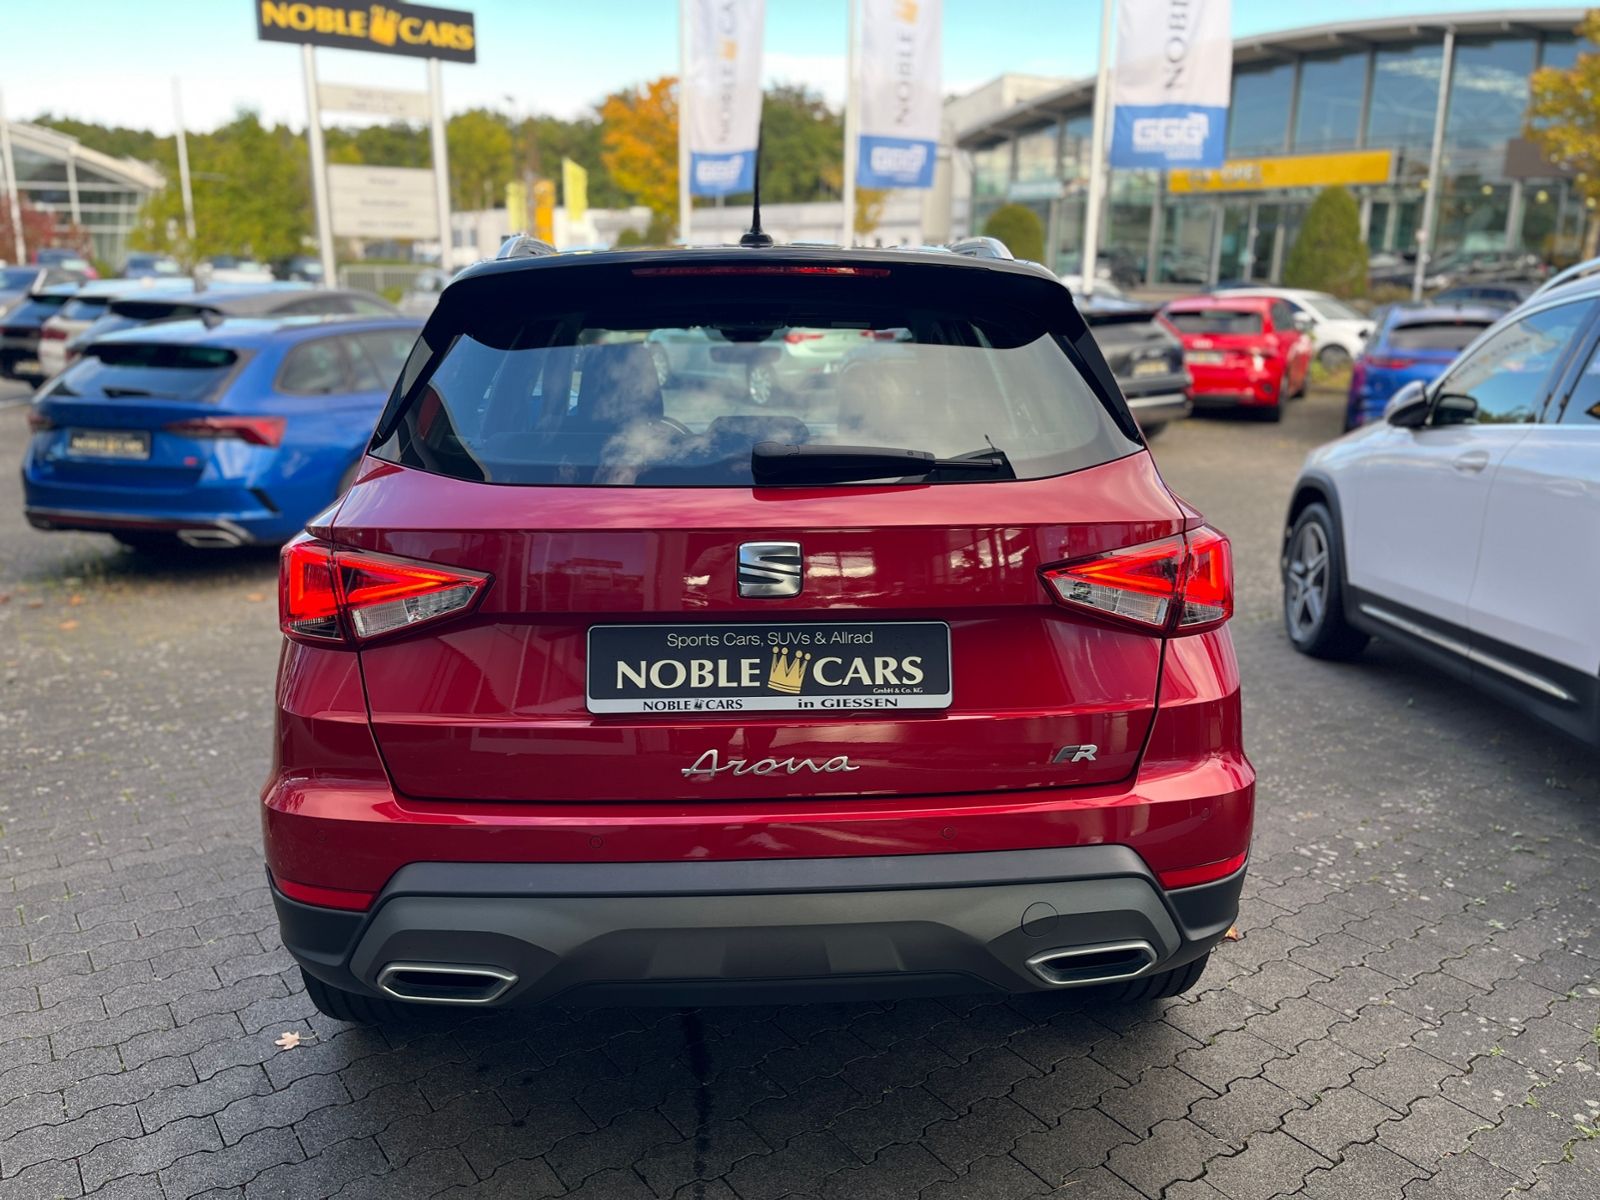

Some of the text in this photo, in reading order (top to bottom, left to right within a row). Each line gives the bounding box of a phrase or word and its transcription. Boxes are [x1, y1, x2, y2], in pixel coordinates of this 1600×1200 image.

[261, 0, 475, 50] NOBLE CARS
[667, 631, 873, 649] Sports Cars, SUVs & Allrad
[616, 656, 924, 689] NOBLE CARS
[643, 697, 898, 711] NOBLE CARS in GIESSEN
[681, 749, 860, 777] Arona
[1052, 744, 1098, 763] FR
